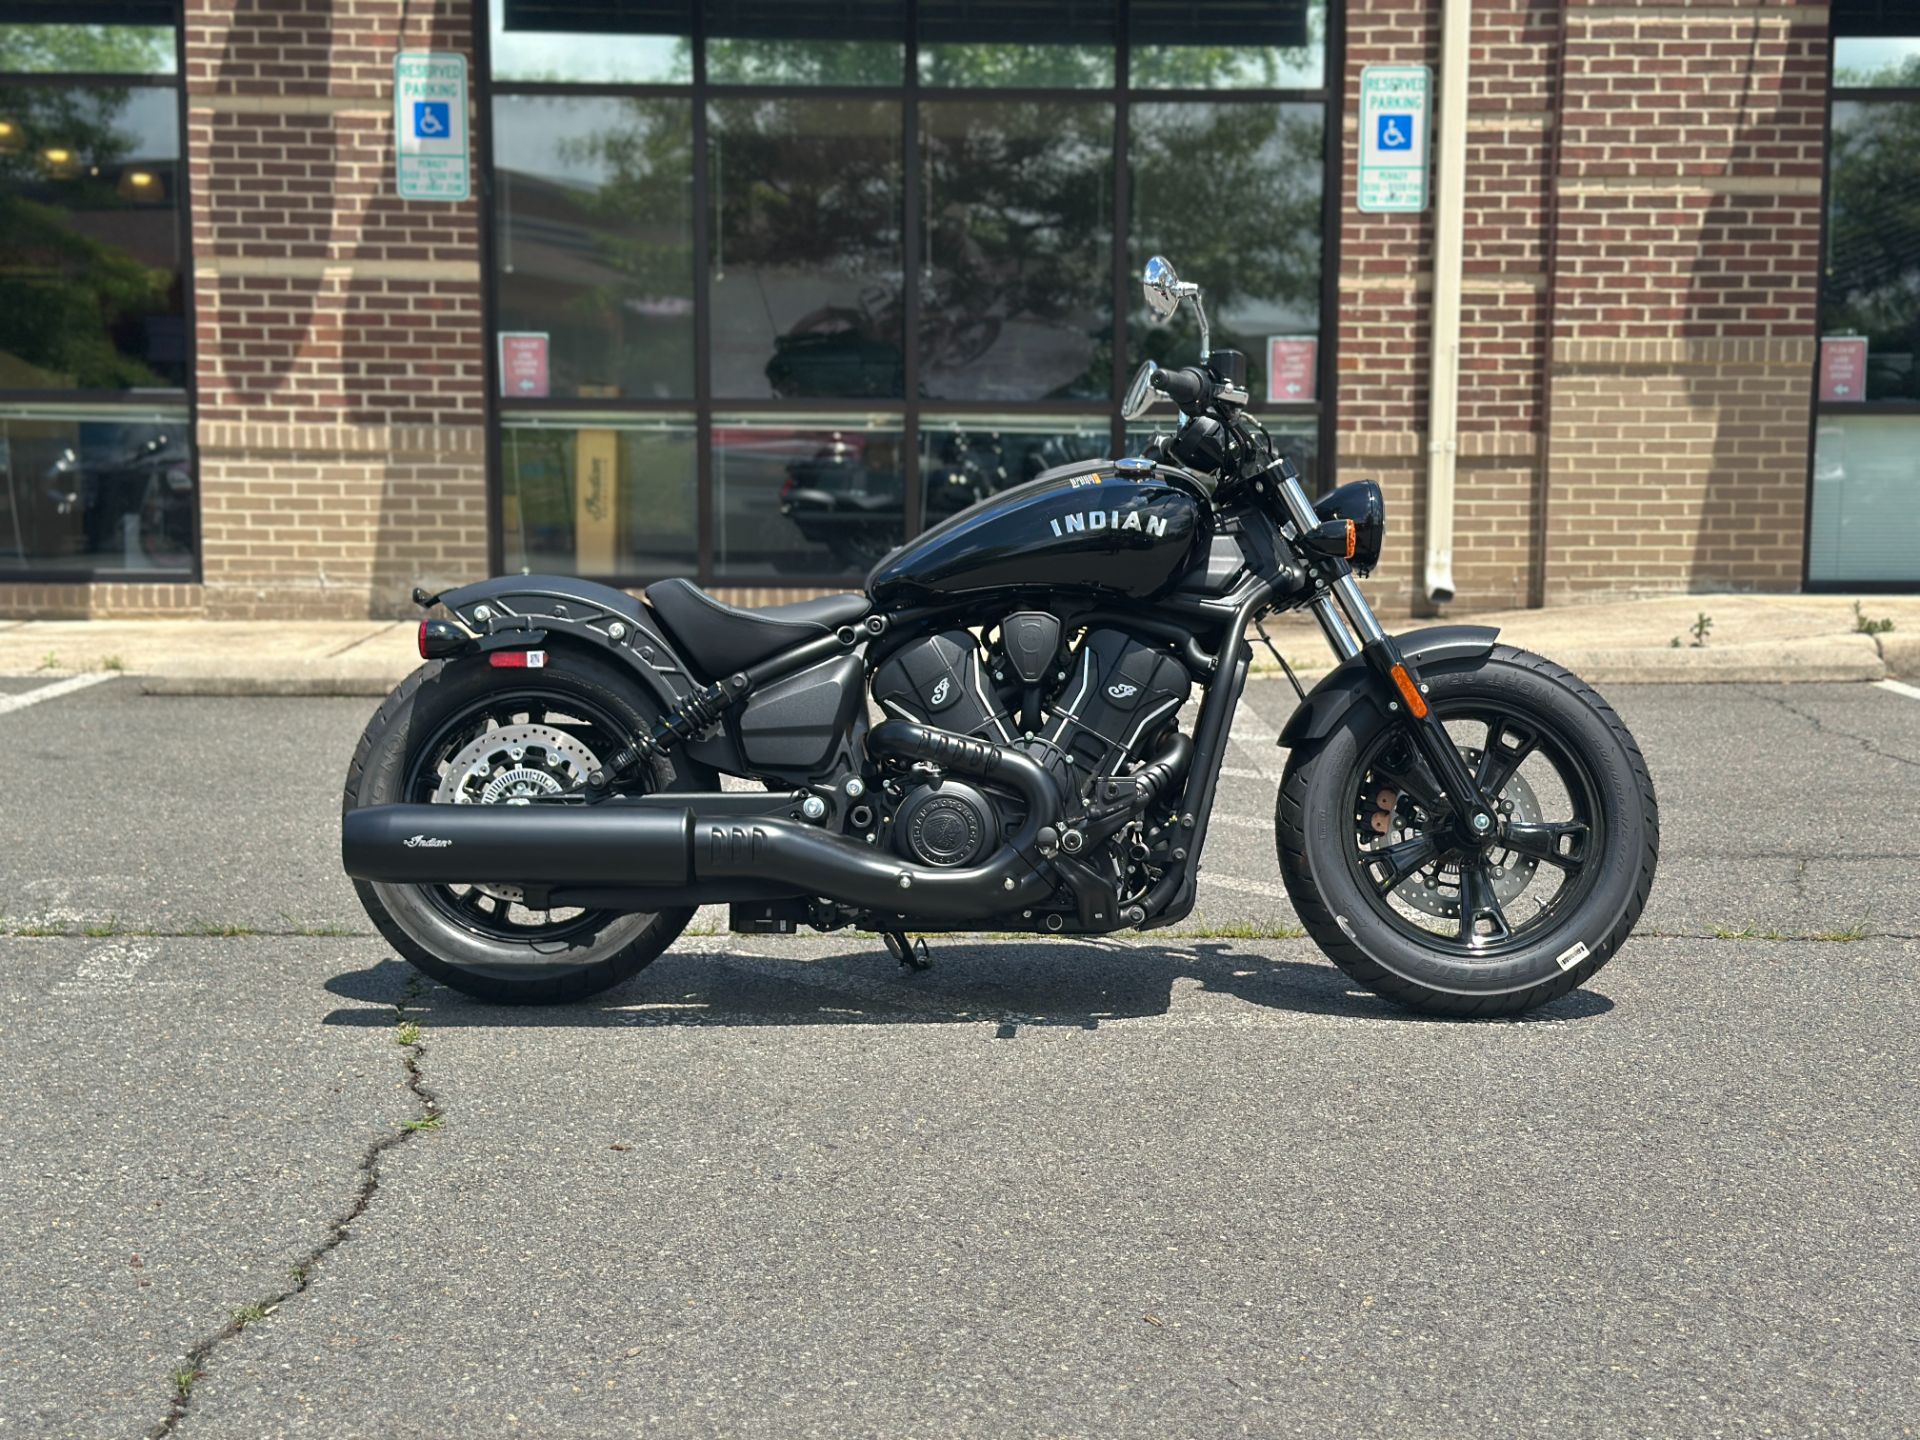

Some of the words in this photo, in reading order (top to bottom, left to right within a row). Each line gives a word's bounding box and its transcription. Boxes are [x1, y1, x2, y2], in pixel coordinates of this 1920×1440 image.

[399, 64, 460, 78] RESERVED
[404, 82, 457, 96] PARKING
[1367, 77, 1425, 91] RESERVED
[1370, 96, 1422, 110] PARKING
[1050, 511, 1167, 537] INDIAN
[403, 834, 453, 848] Indian
